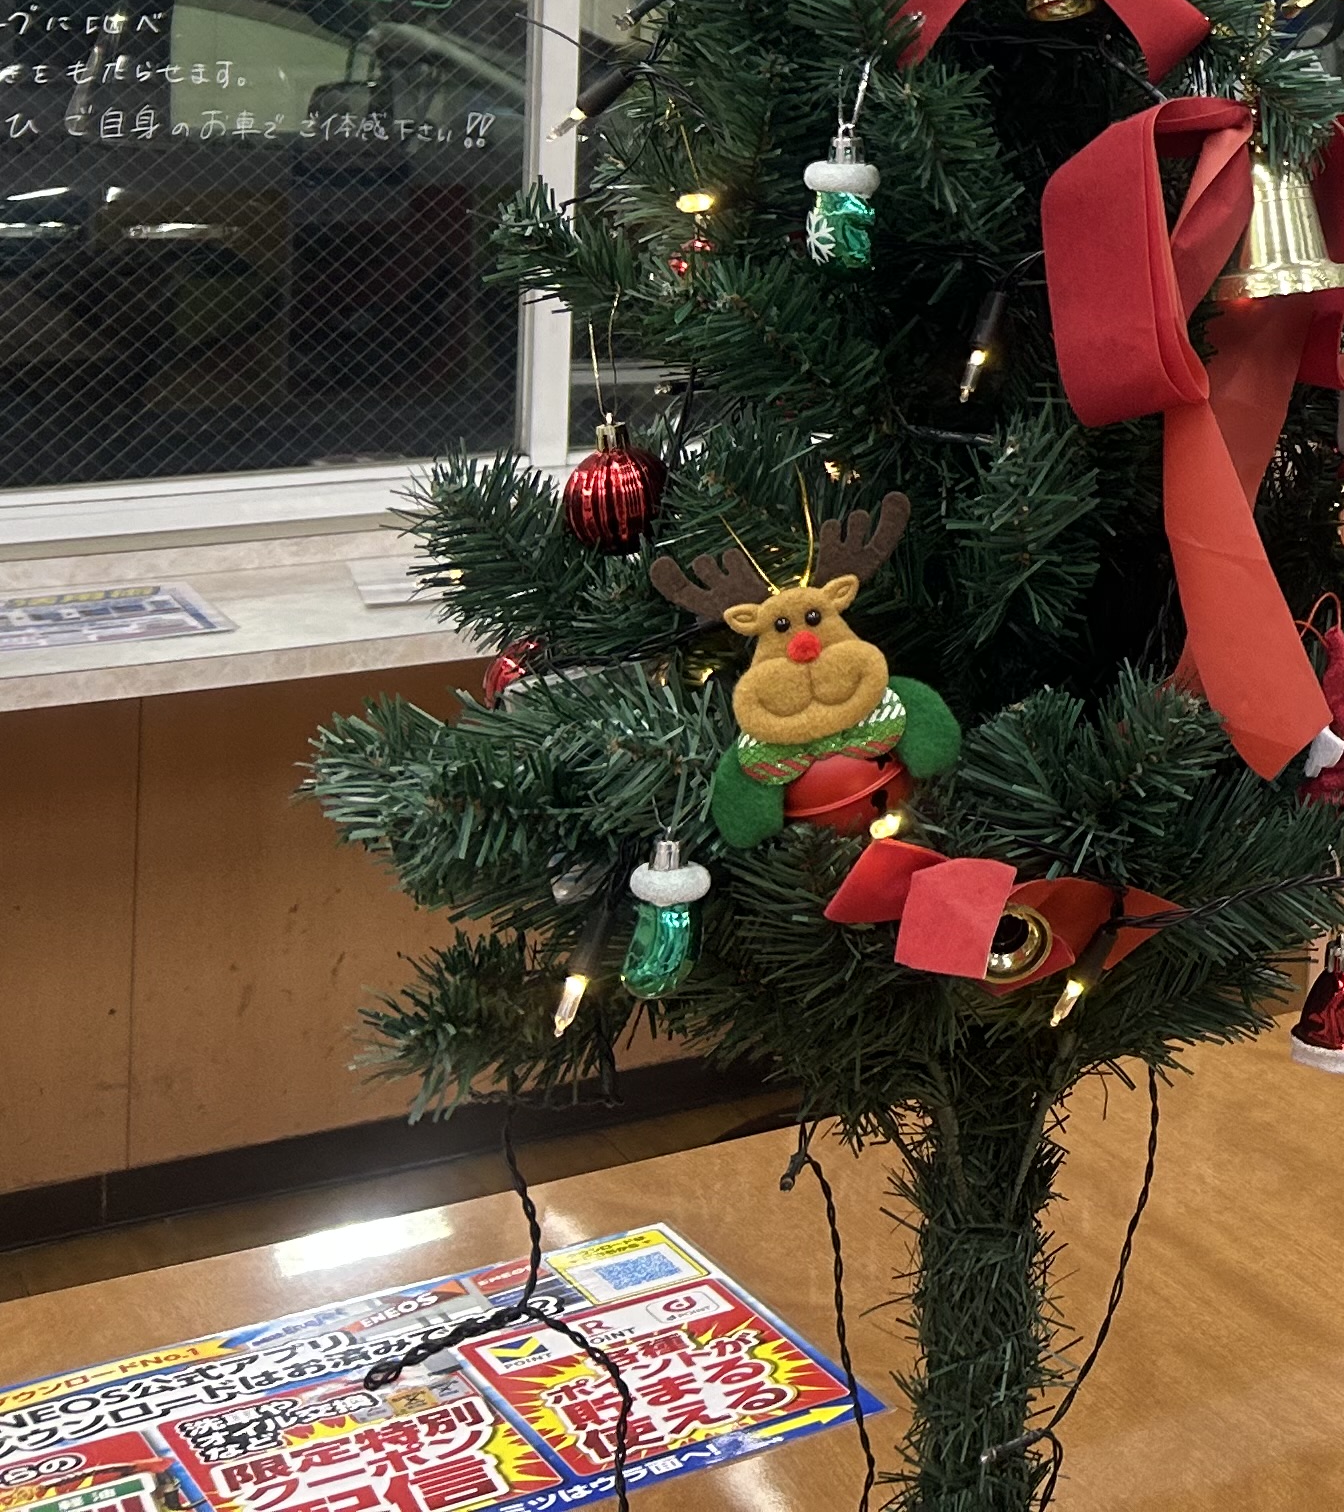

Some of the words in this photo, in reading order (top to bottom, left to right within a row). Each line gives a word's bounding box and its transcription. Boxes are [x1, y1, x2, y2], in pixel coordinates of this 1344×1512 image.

[361, 1291, 439, 1328] ENEOS
[219, 1399, 485, 1492] 限定特別
[249, 1429, 482, 1511] クーポン
